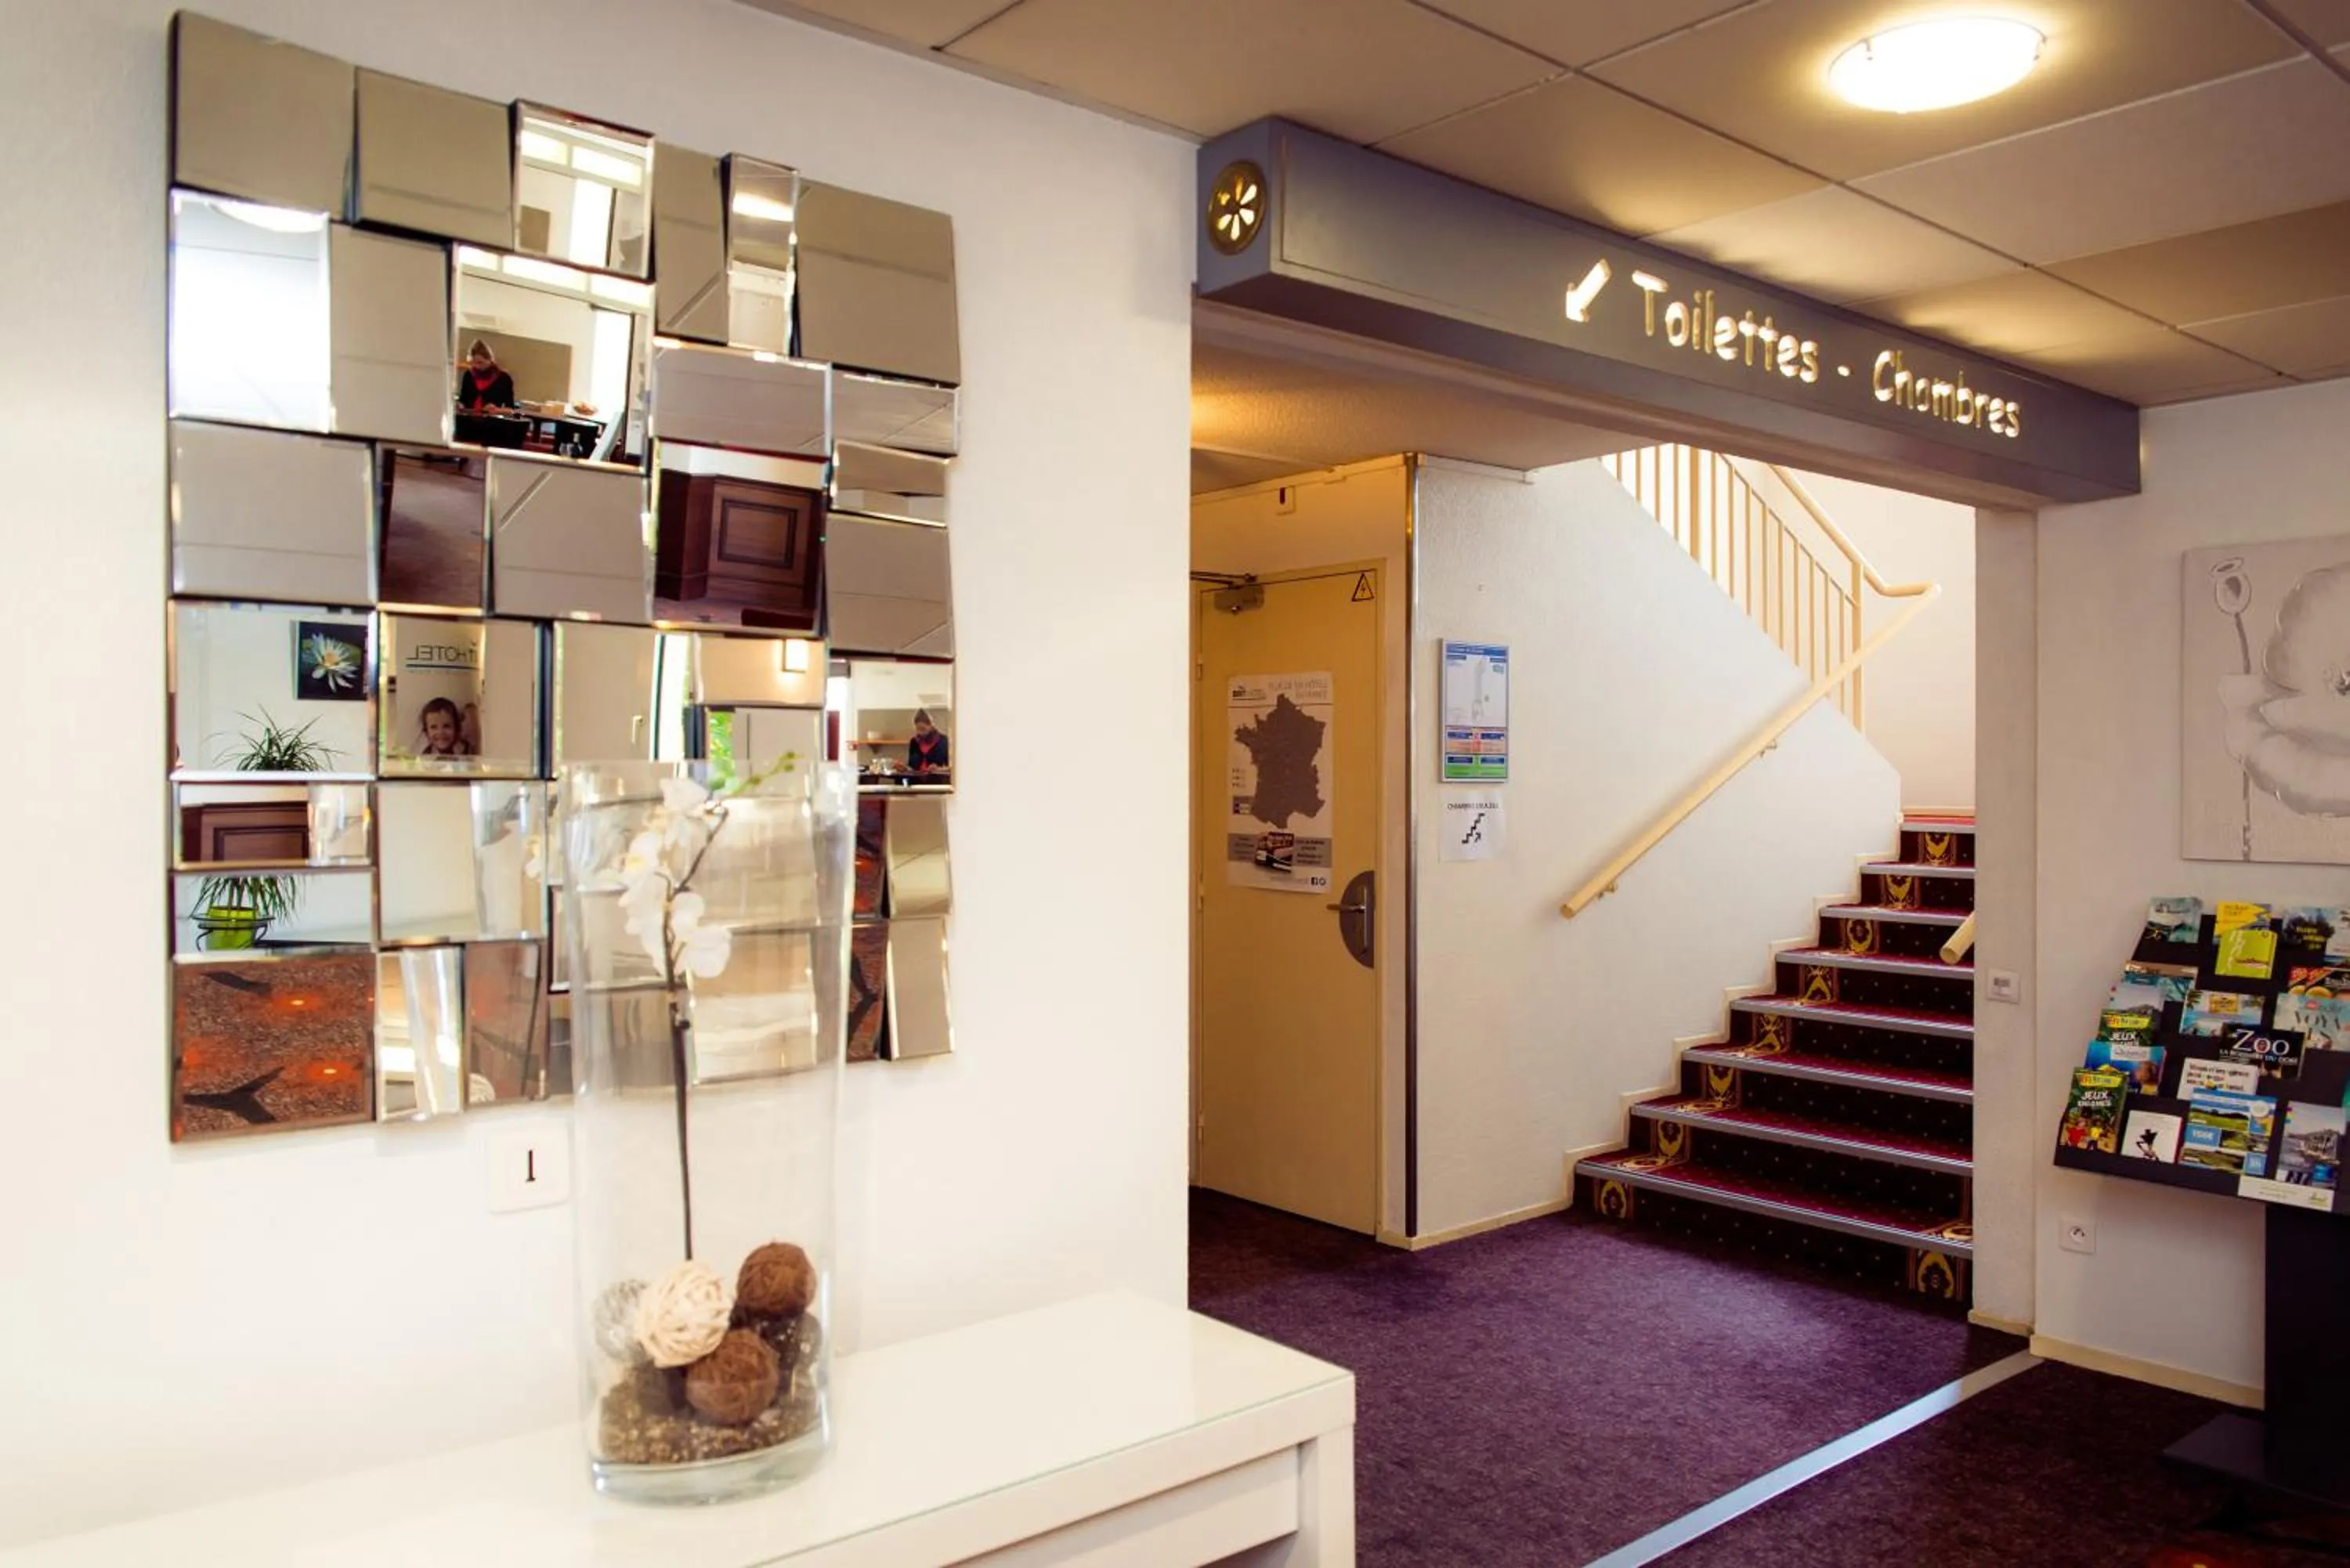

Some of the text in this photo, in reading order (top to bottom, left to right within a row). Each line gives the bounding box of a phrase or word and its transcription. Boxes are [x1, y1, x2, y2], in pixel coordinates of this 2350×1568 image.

[1632, 270, 1818, 382] Toilettes
[1873, 350, 2019, 437] Chambres
[2232, 1028, 2289, 1054] Zoo
[2081, 1090, 2108, 1100] JEUX
